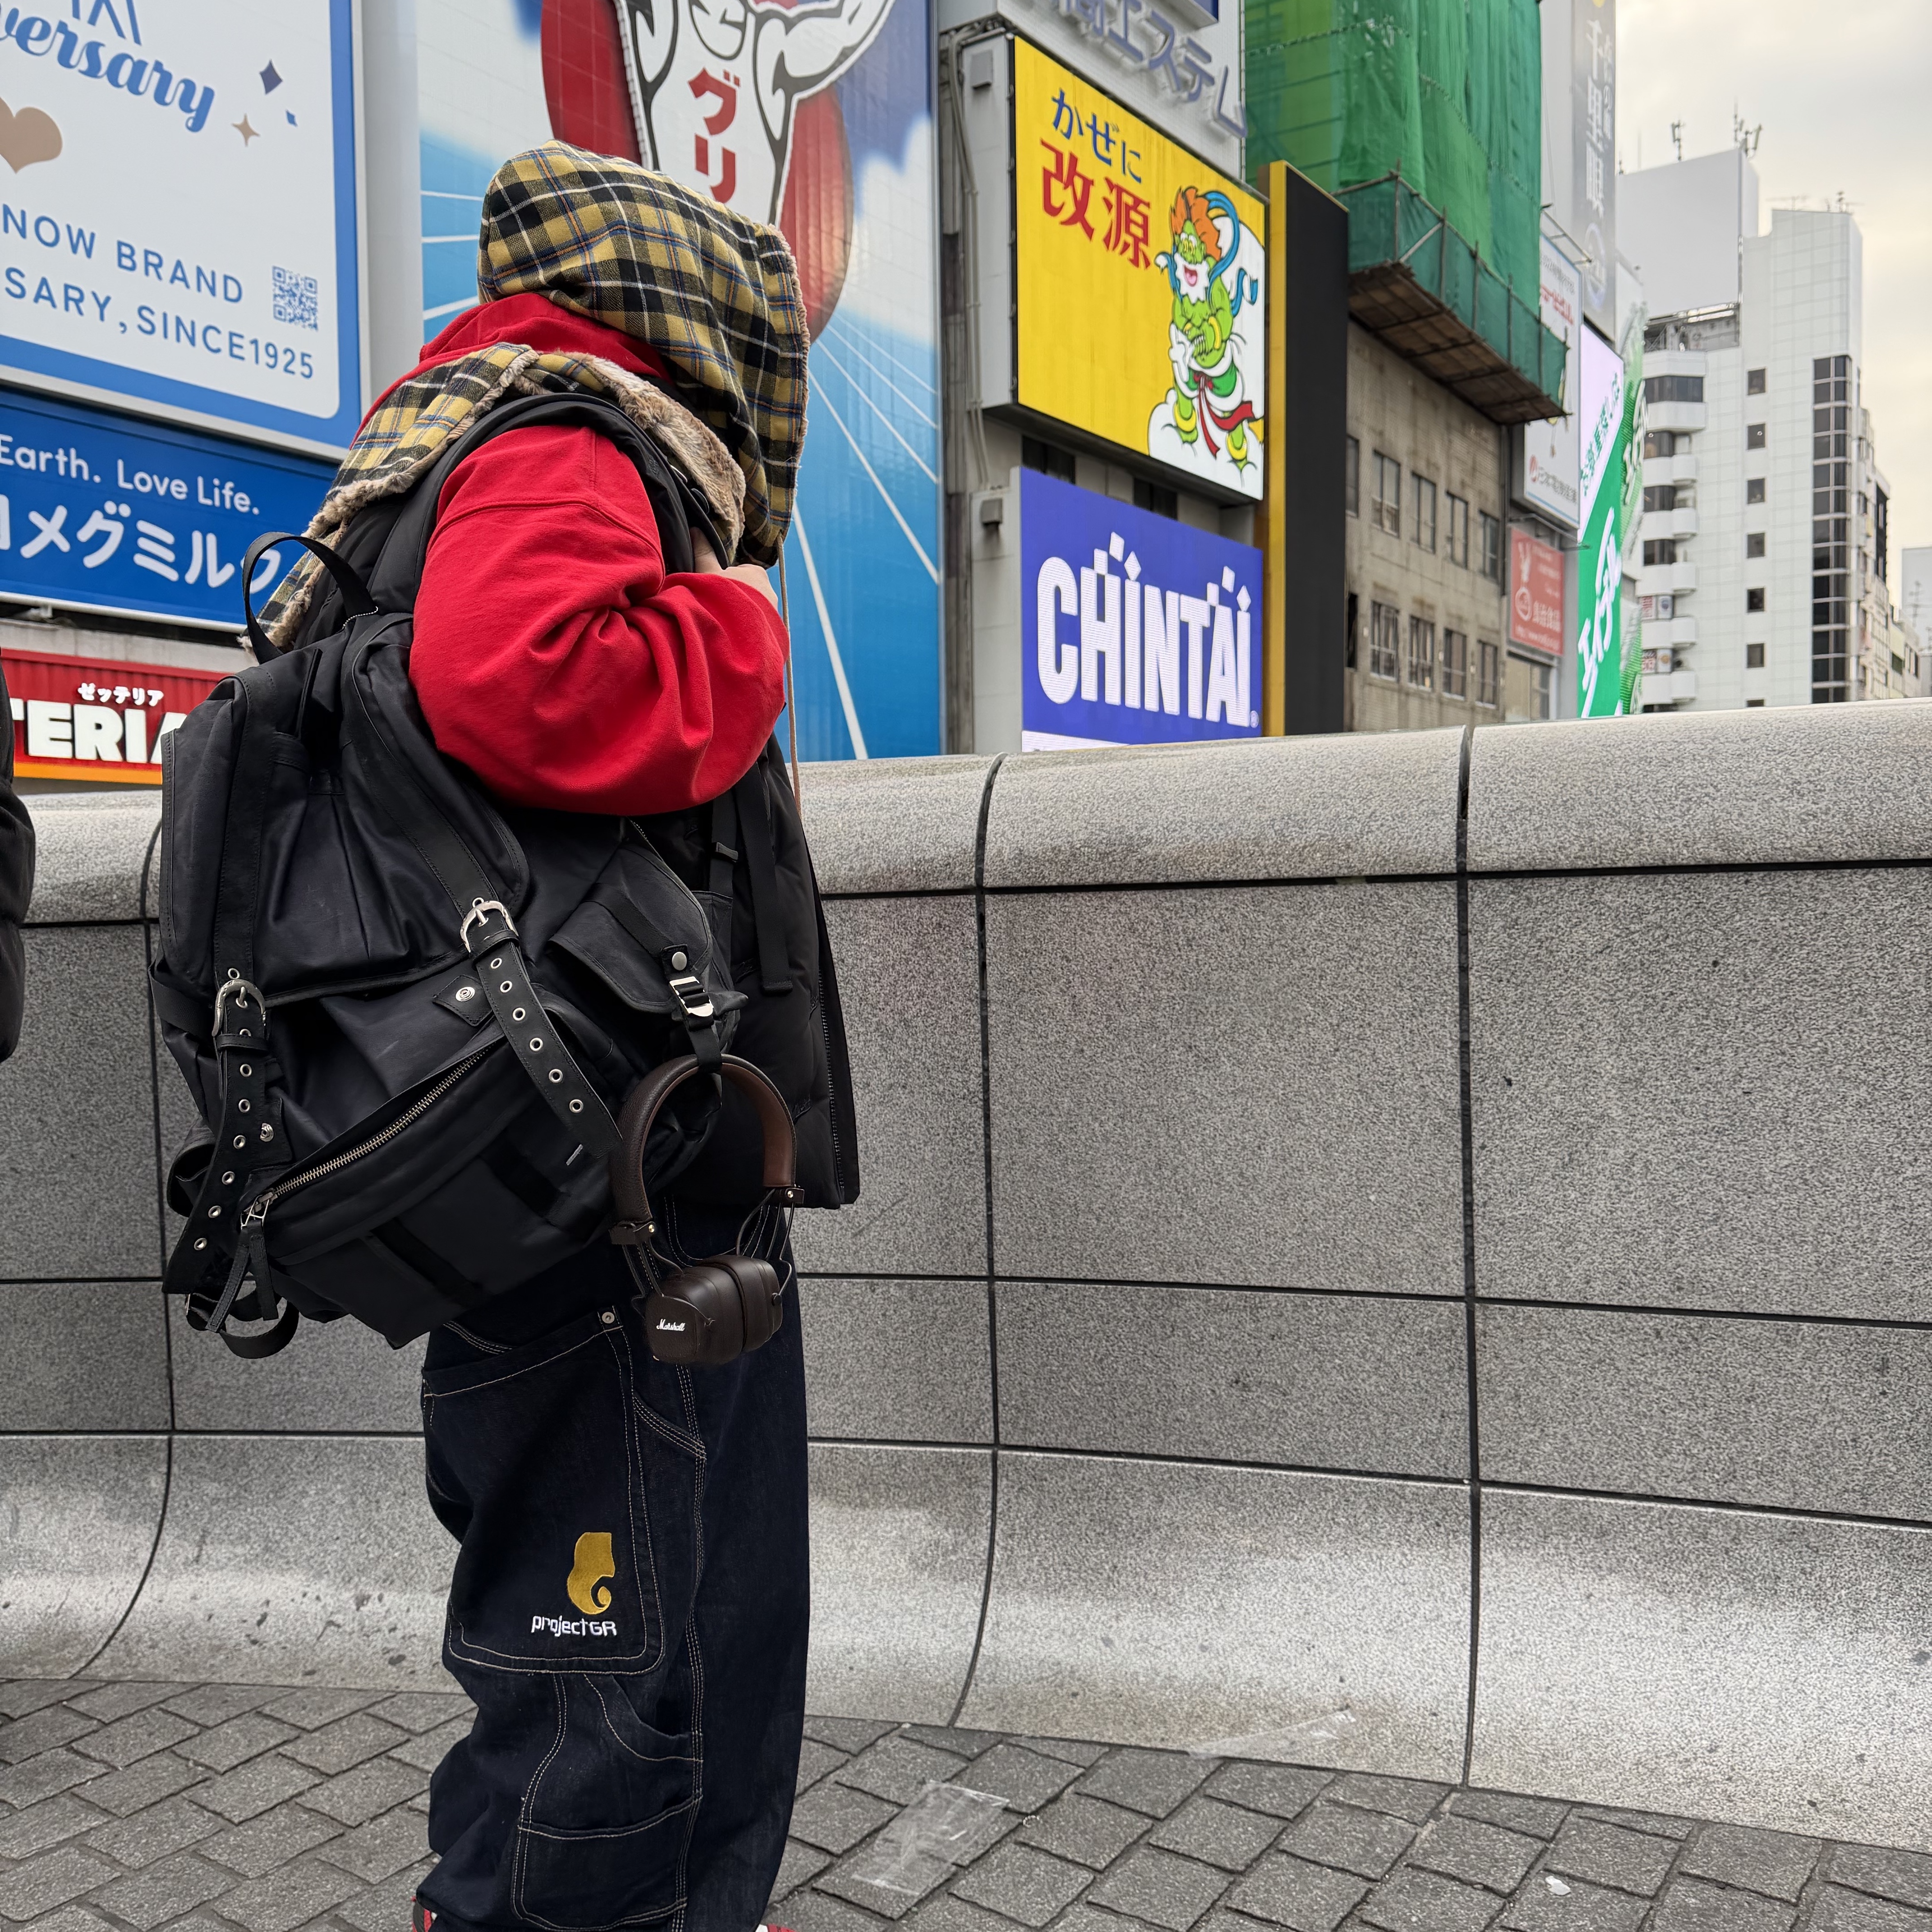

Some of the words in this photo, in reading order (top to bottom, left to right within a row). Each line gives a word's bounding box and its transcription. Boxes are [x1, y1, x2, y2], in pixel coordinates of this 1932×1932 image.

[687, 67, 741, 204] グリ
[1051, 87, 1142, 184] かぜに
[1040, 138, 1151, 271] 改源
[2, 203, 96, 259] NOW
[116, 240, 244, 304] BRAND
[117, 459, 189, 501] Love
[197, 476, 260, 515] Life.
[77, 682, 164, 707] ゼッテリア
[656, 1318, 686, 1332] Marshall
